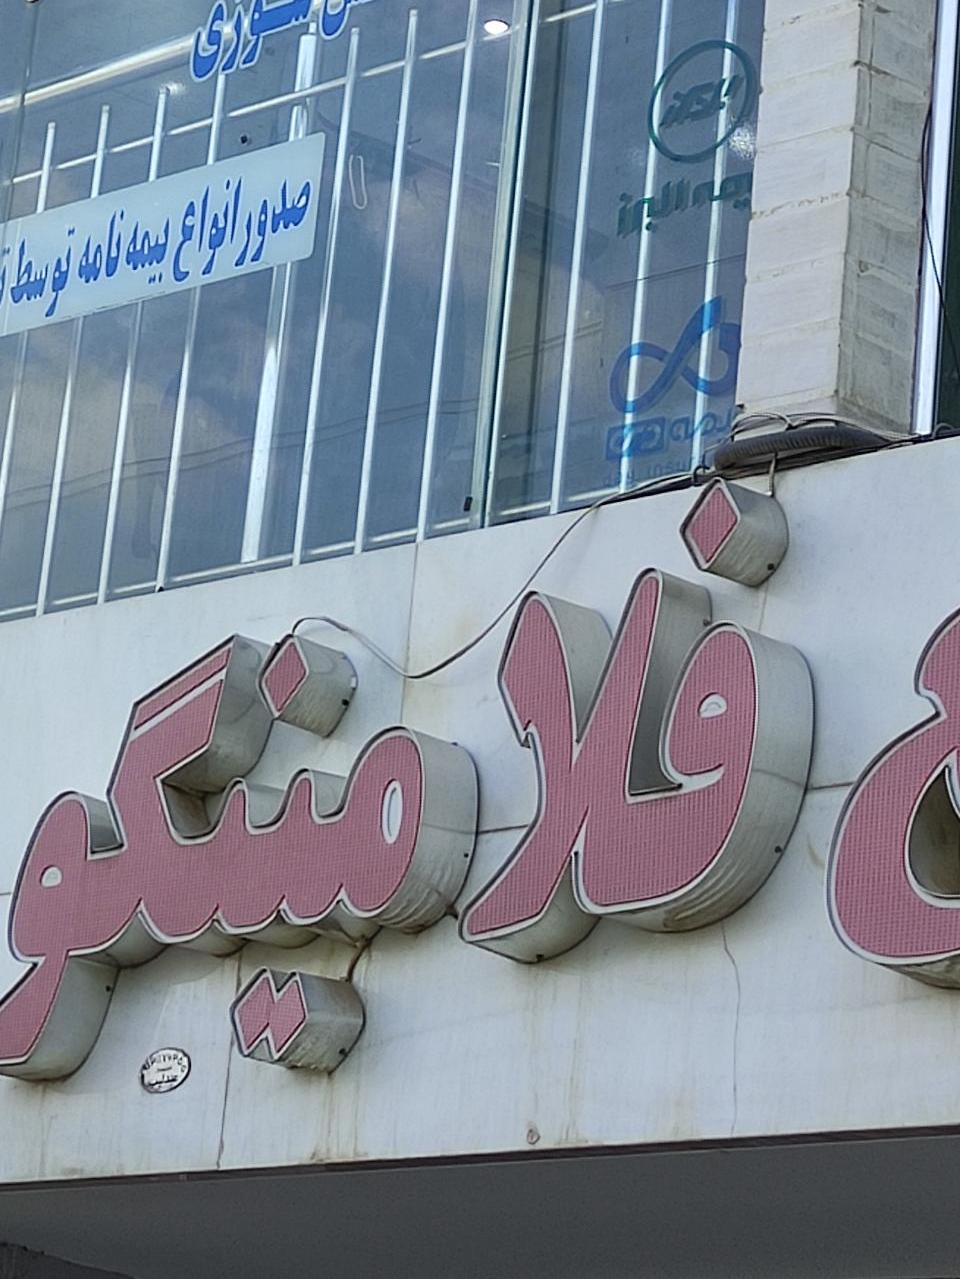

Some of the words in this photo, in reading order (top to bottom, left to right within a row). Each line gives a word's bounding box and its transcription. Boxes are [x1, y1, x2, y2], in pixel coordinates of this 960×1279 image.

[78, 209, 124, 284] نامه
[125, 217, 170, 285] بیمه
[173, 175, 243, 282] انواع
[234, 178, 312, 268] صدور
[10, 228, 75, 318] توسط
